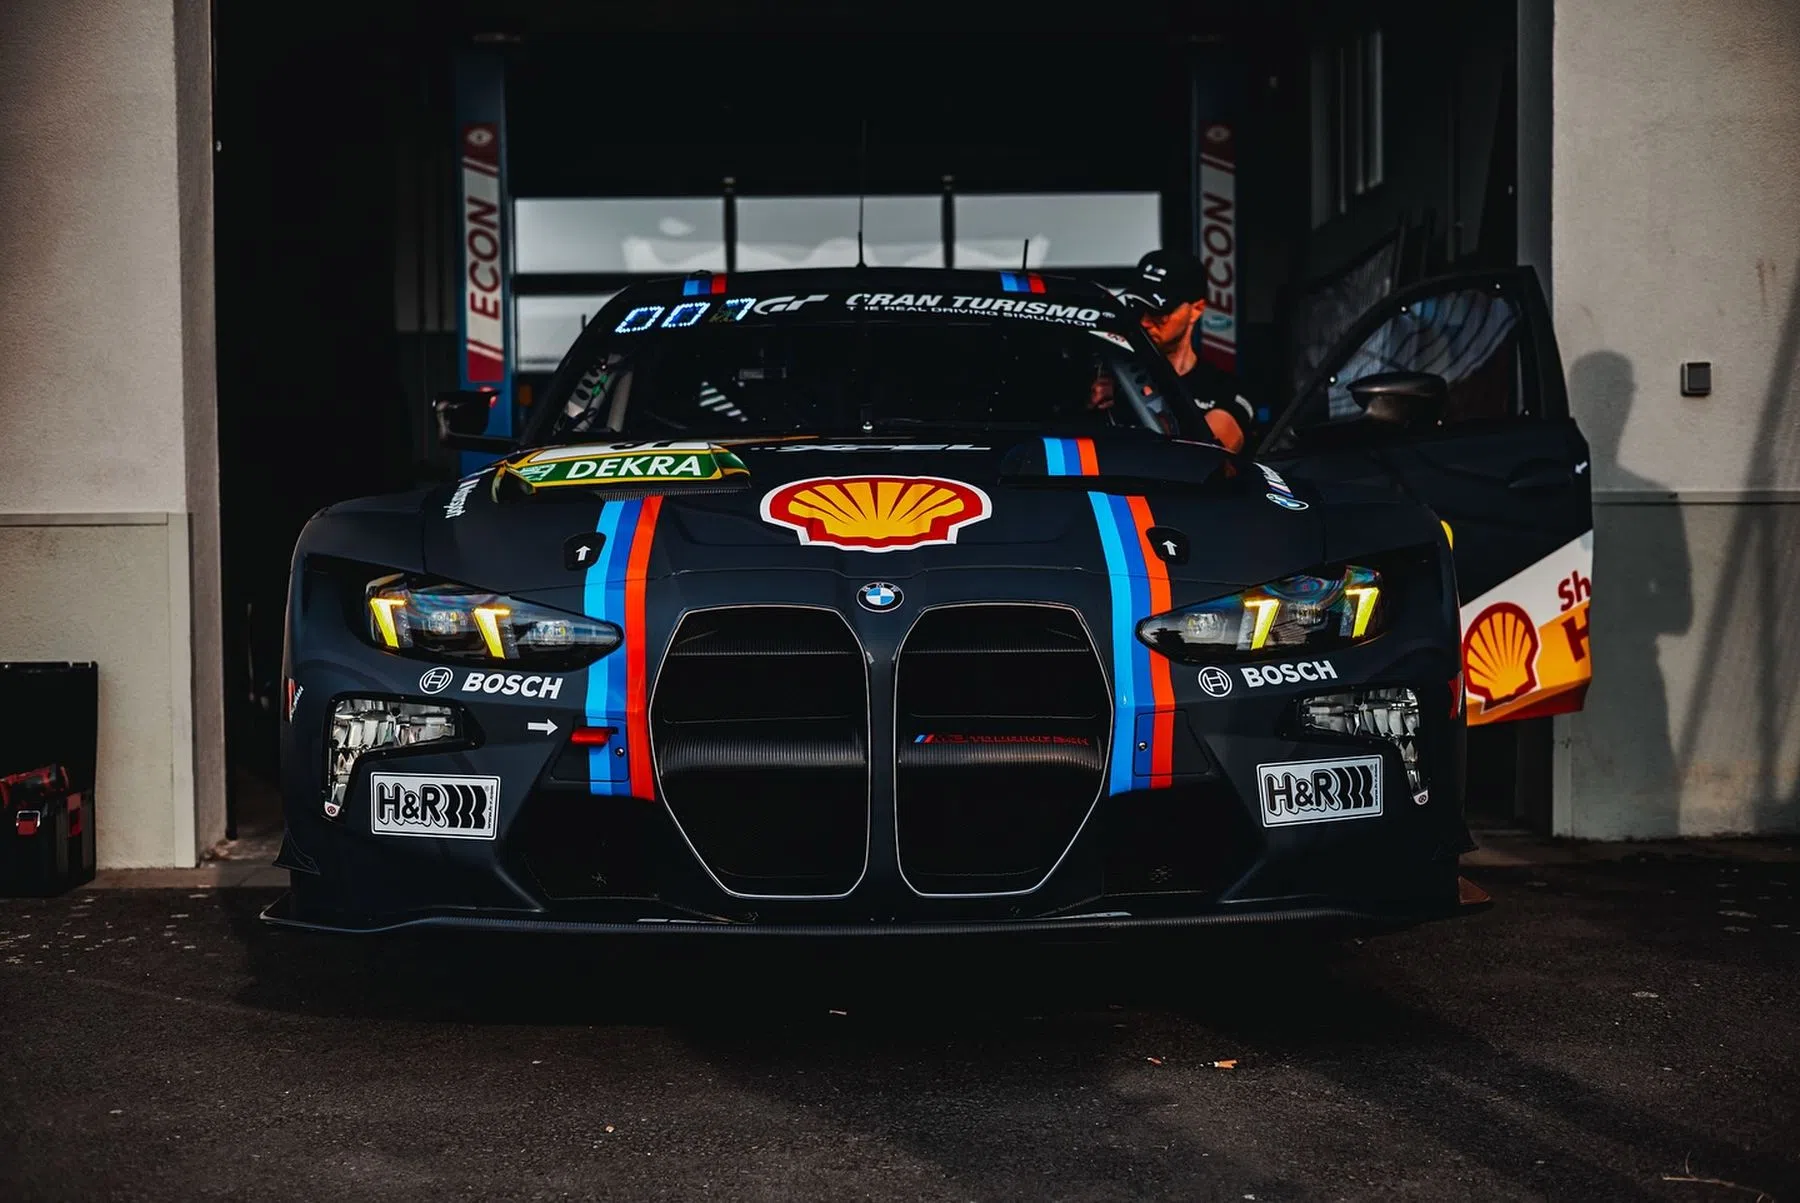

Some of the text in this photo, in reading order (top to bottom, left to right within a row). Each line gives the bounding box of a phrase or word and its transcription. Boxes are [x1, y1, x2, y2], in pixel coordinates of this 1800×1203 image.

[467, 196, 500, 320] ECON
[1203, 193, 1234, 315] ECON
[845, 293, 943, 307] GRAN
[933, 307, 999, 318] DRIVING
[1002, 311, 1098, 328] SIMULATOR
[566, 455, 703, 480] DEKRA
[461, 672, 564, 700] BOSCH
[1240, 660, 1338, 689] BOSCH
[377, 783, 446, 826] H&R
[1266, 769, 1339, 815] H&R
